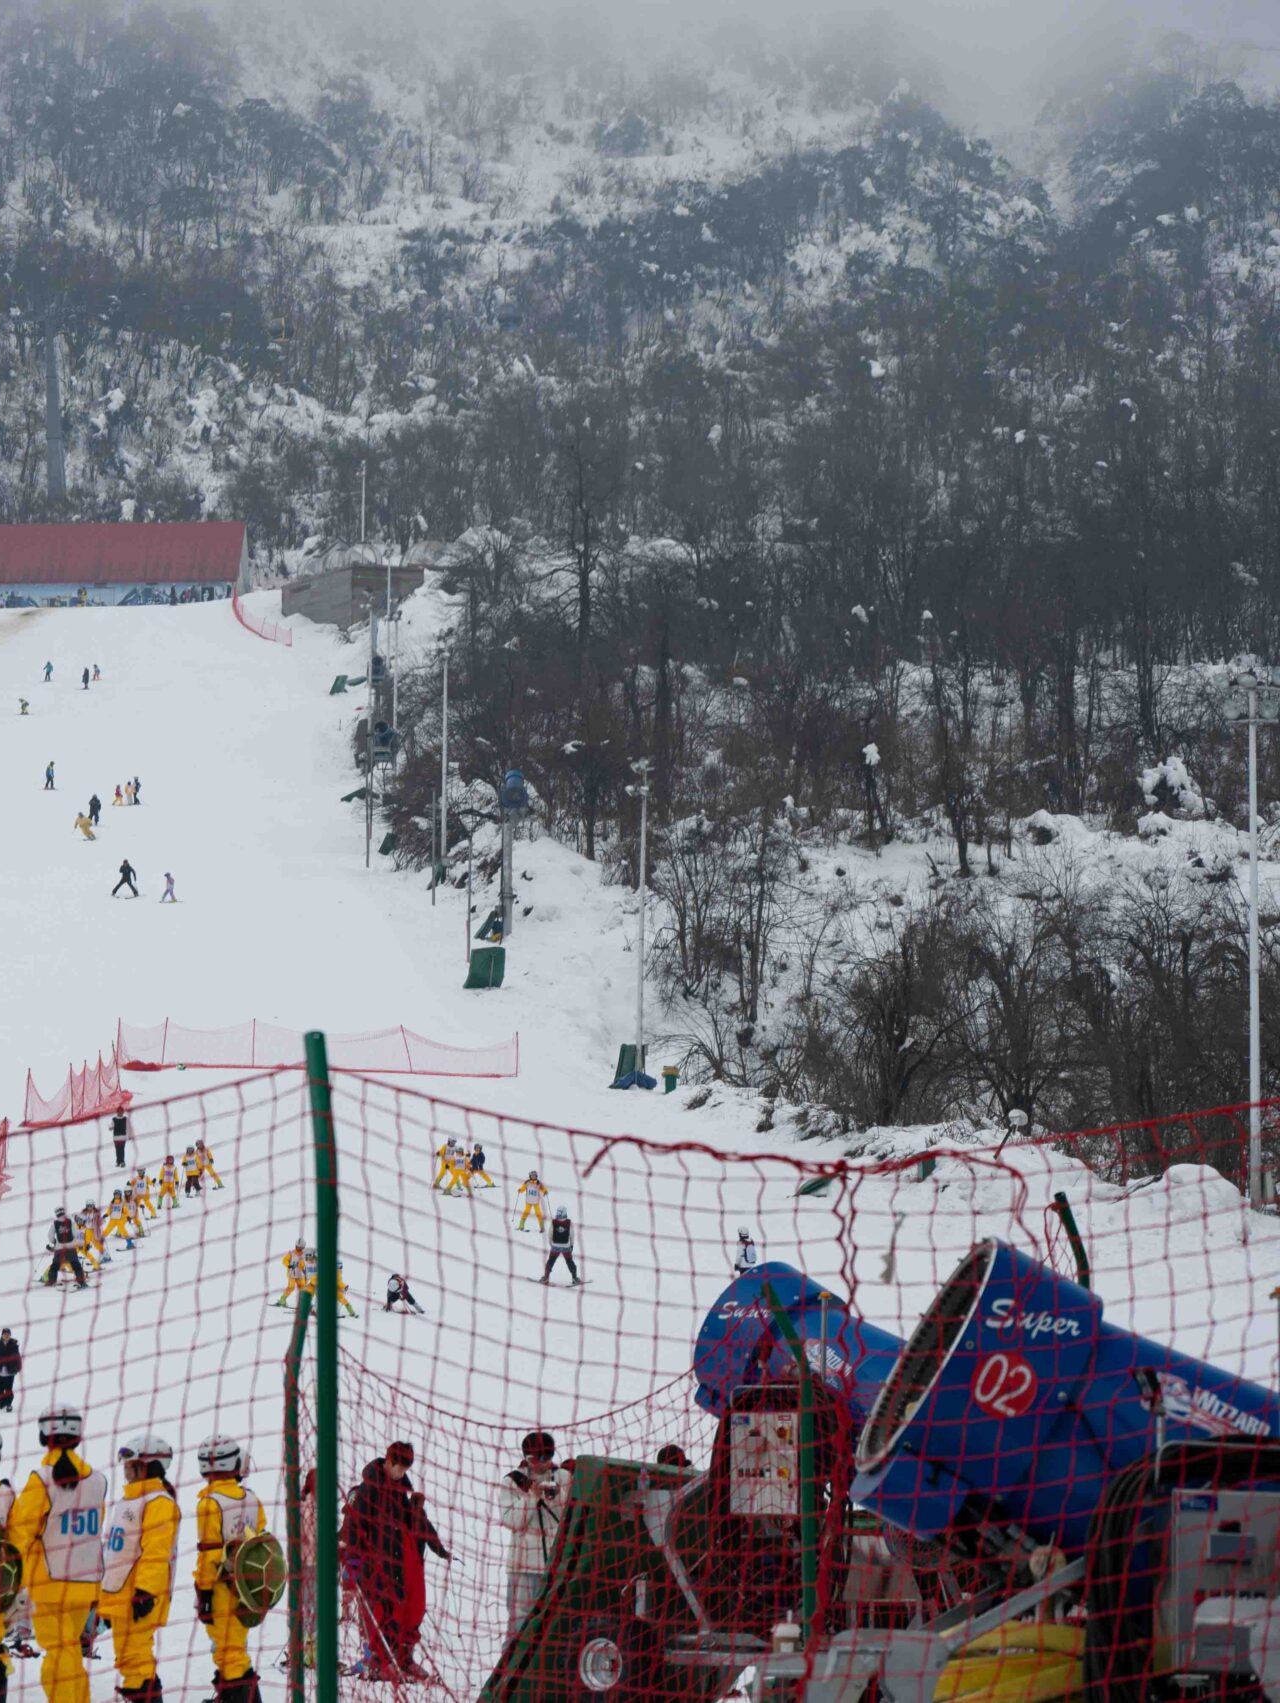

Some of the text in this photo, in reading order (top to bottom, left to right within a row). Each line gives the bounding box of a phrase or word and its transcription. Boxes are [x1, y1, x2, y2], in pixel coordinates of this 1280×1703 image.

[985, 1298, 1081, 1339] Super
[975, 1354, 1032, 1417] 02
[60, 1507, 99, 1536] 150
